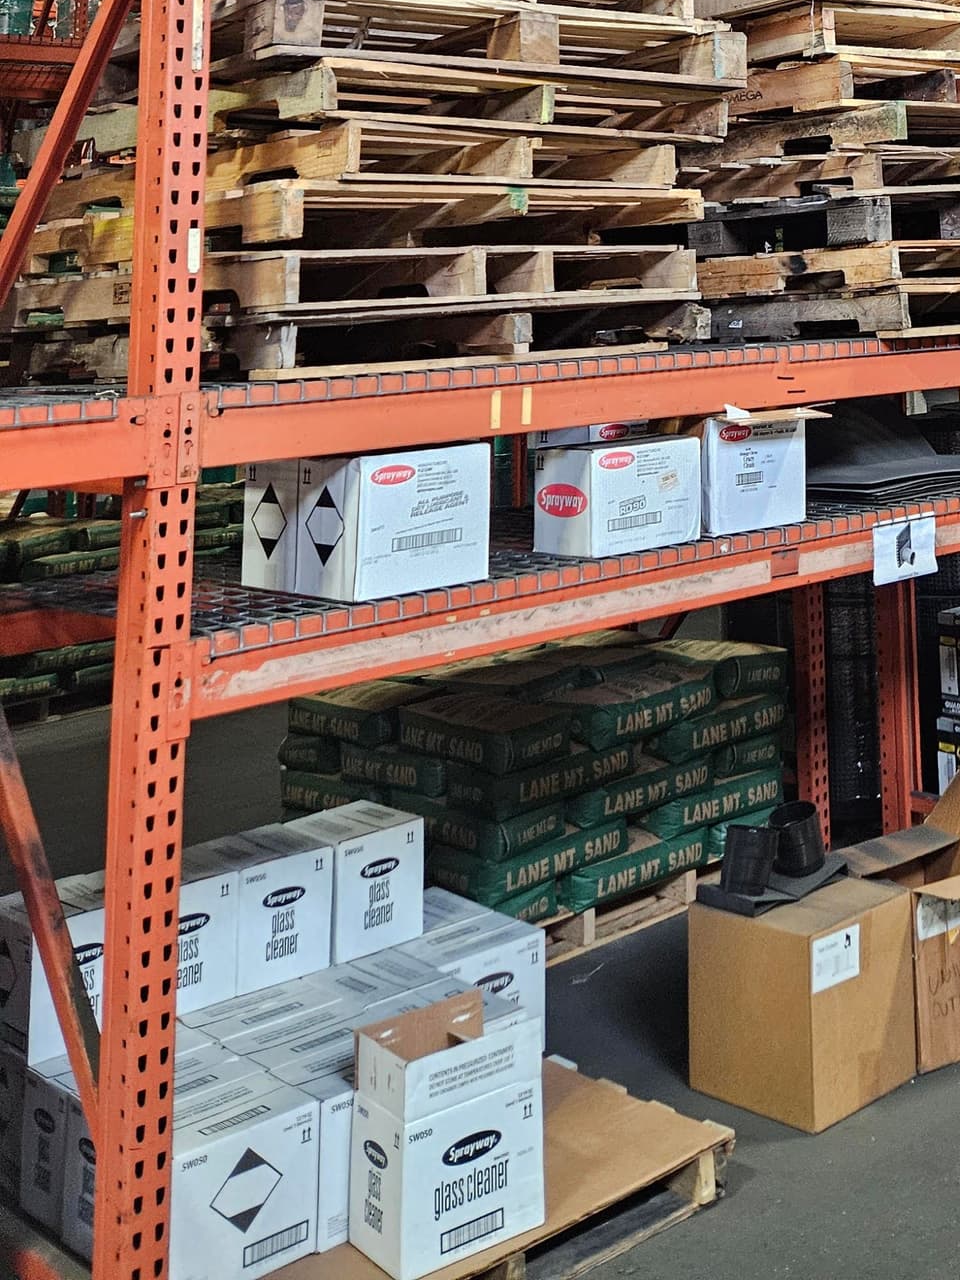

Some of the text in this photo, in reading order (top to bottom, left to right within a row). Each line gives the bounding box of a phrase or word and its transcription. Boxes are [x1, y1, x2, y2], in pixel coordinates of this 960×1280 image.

[721, 429, 750, 440] Sprayway
[373, 466, 414, 484] Sprayway
[601, 454, 633, 468] Sprayway
[541, 492, 584, 511] Sprayway
[616, 687, 712, 735] LANE MT. SAND
[692, 704, 784, 749] LANE MT. SAND
[519, 775, 559, 802] LANE
[593, 750, 629, 779] SAND
[604, 766, 709, 816] LANE MT. SAND
[684, 780, 778, 826] LANE MT. SAND
[506, 830, 621, 892] LANE MT. SAND
[598, 841, 703, 898] LANE MT. SAND
[369, 879, 390, 909] glass
[271, 909, 295, 938] glass
[363, 903, 394, 931] cleaner
[265, 932, 299, 962] cleaner
[177, 961, 204, 989] eaner
[408, 1128, 433, 1145] SW050
[448, 1133, 497, 1163] Sprayway
[181, 1153, 208, 1173] SW050
[434, 1158, 510, 1222] glass cleaner
